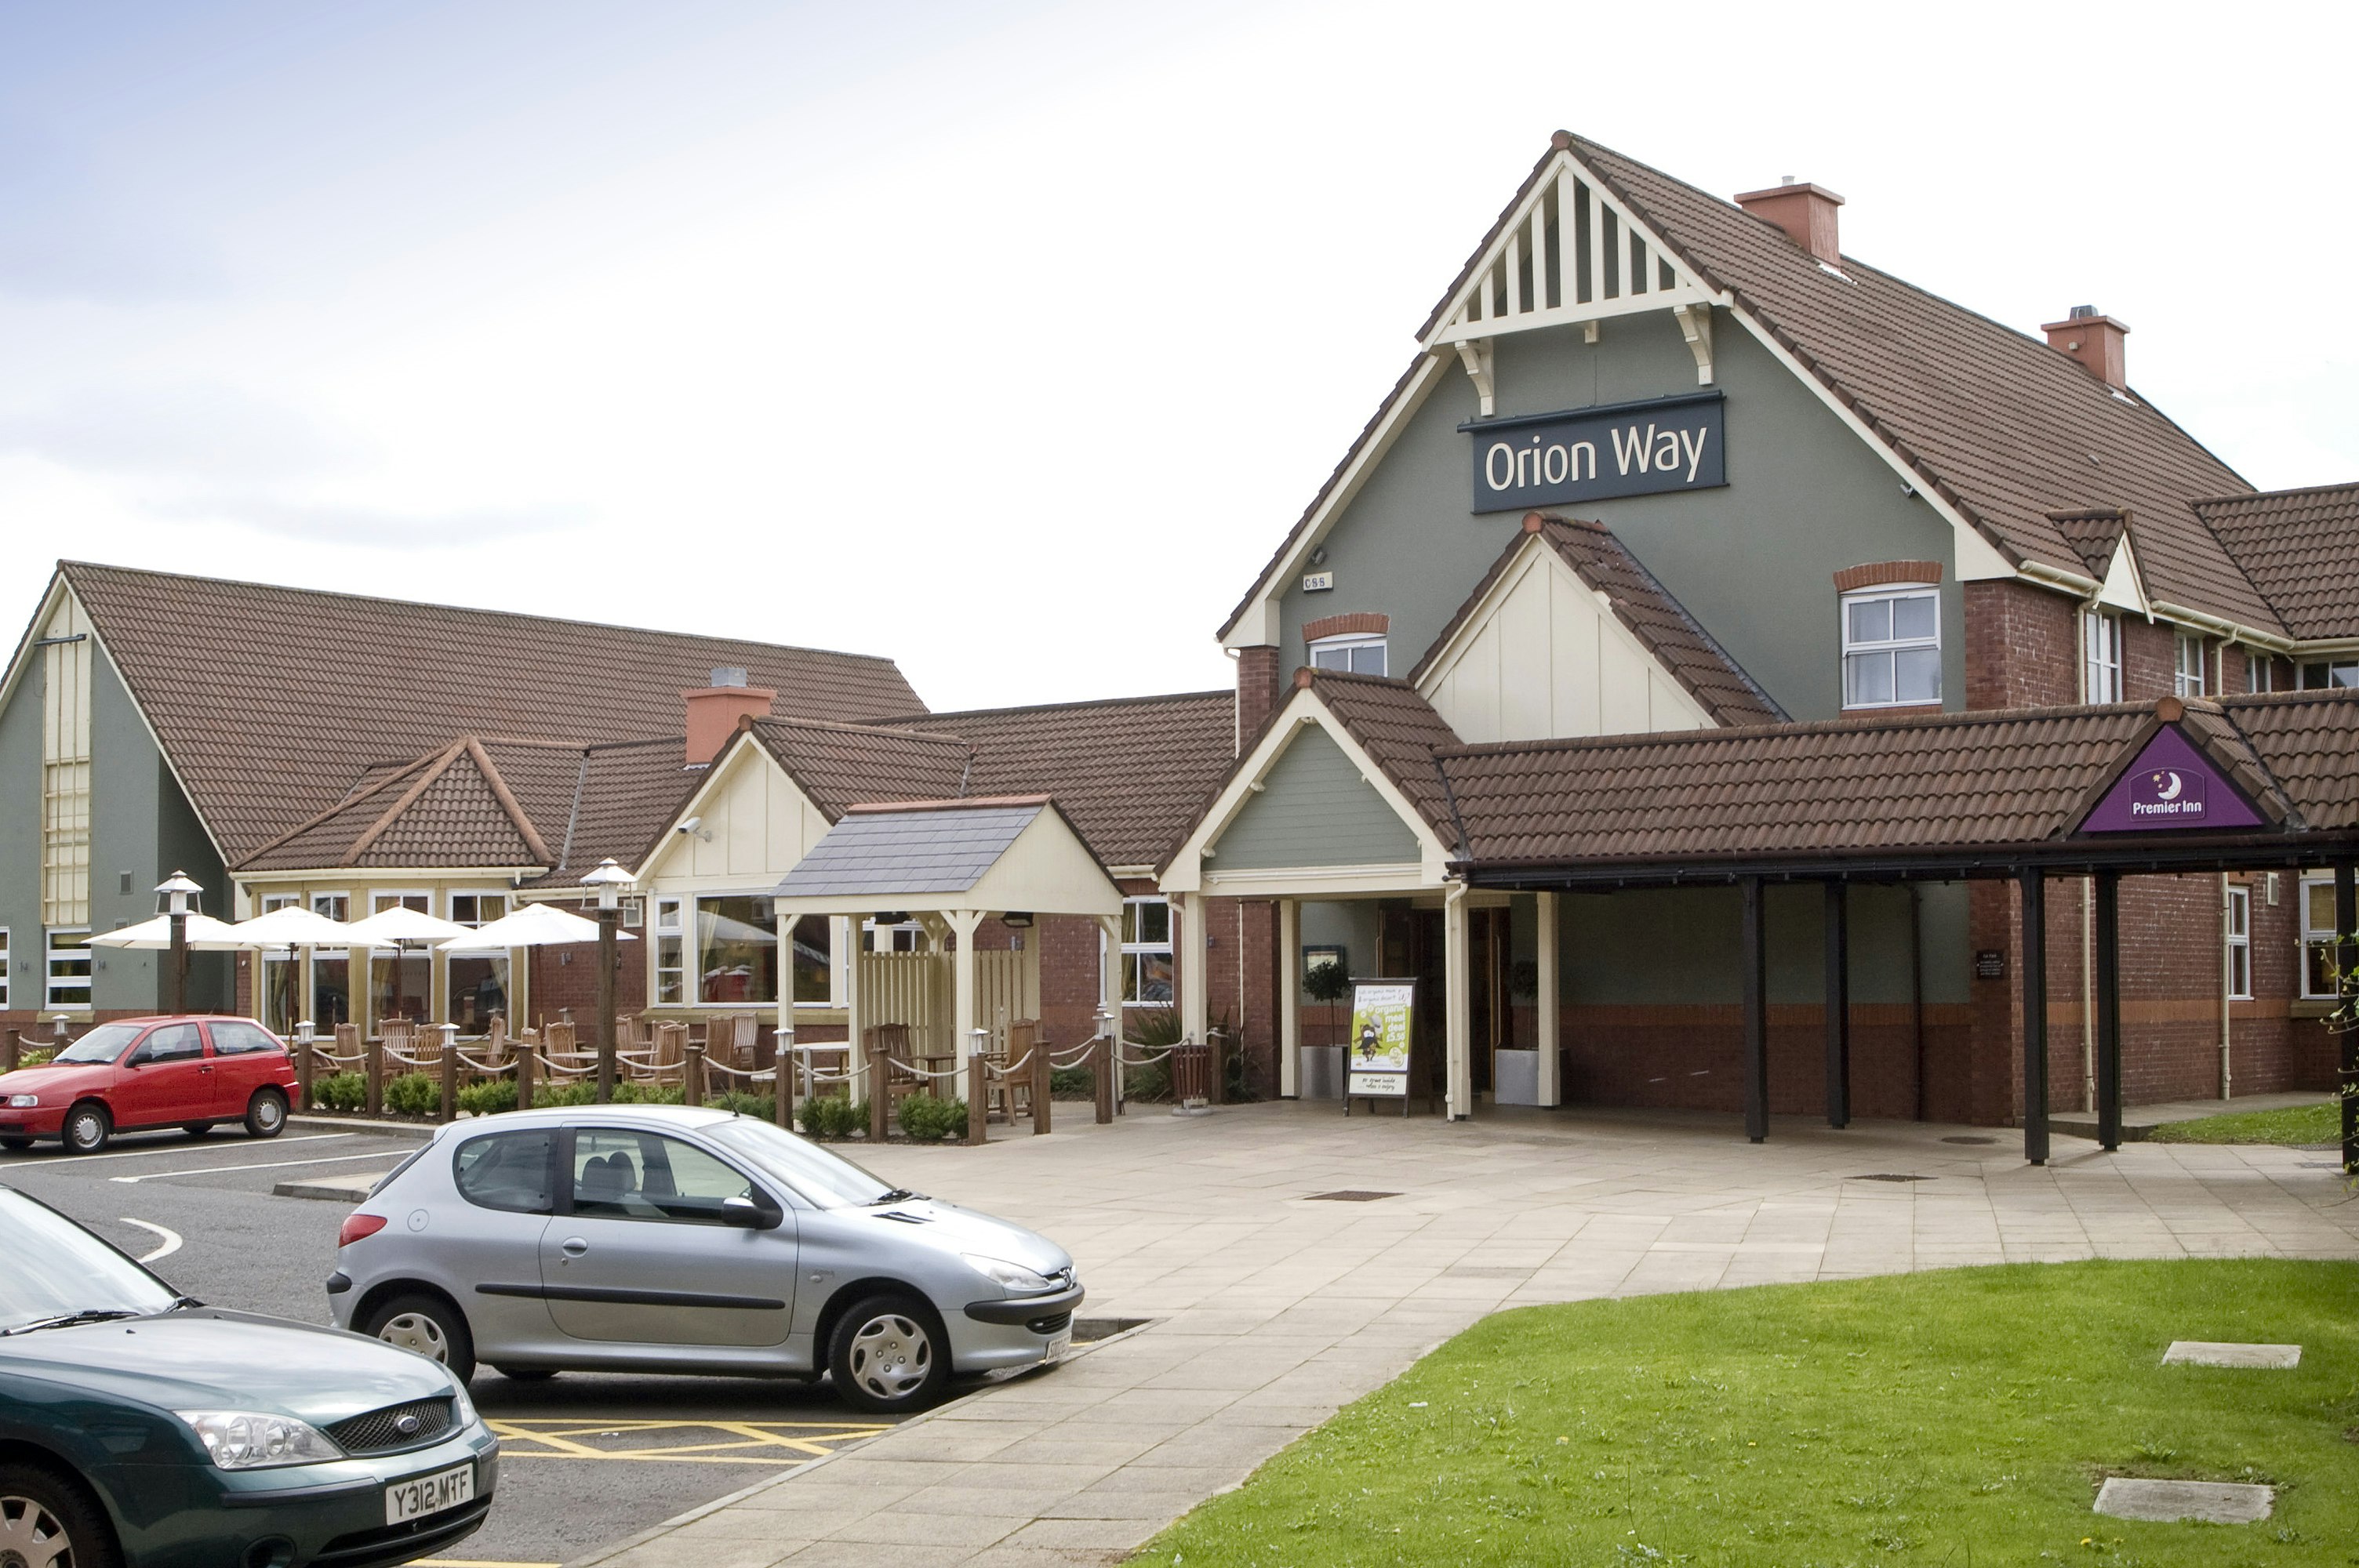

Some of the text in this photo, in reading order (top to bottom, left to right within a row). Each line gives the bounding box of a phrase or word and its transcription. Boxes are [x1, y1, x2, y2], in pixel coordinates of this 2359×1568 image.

[1485, 423, 1707, 491] Orion Way
[2132, 800, 2202, 815] Premier Inn
[1374, 1004, 1406, 1015] organic
[1385, 1011, 1405, 1023] meal
[1387, 1022, 1405, 1033] deal
[394, 1470, 468, 1517] Y312 MTF
